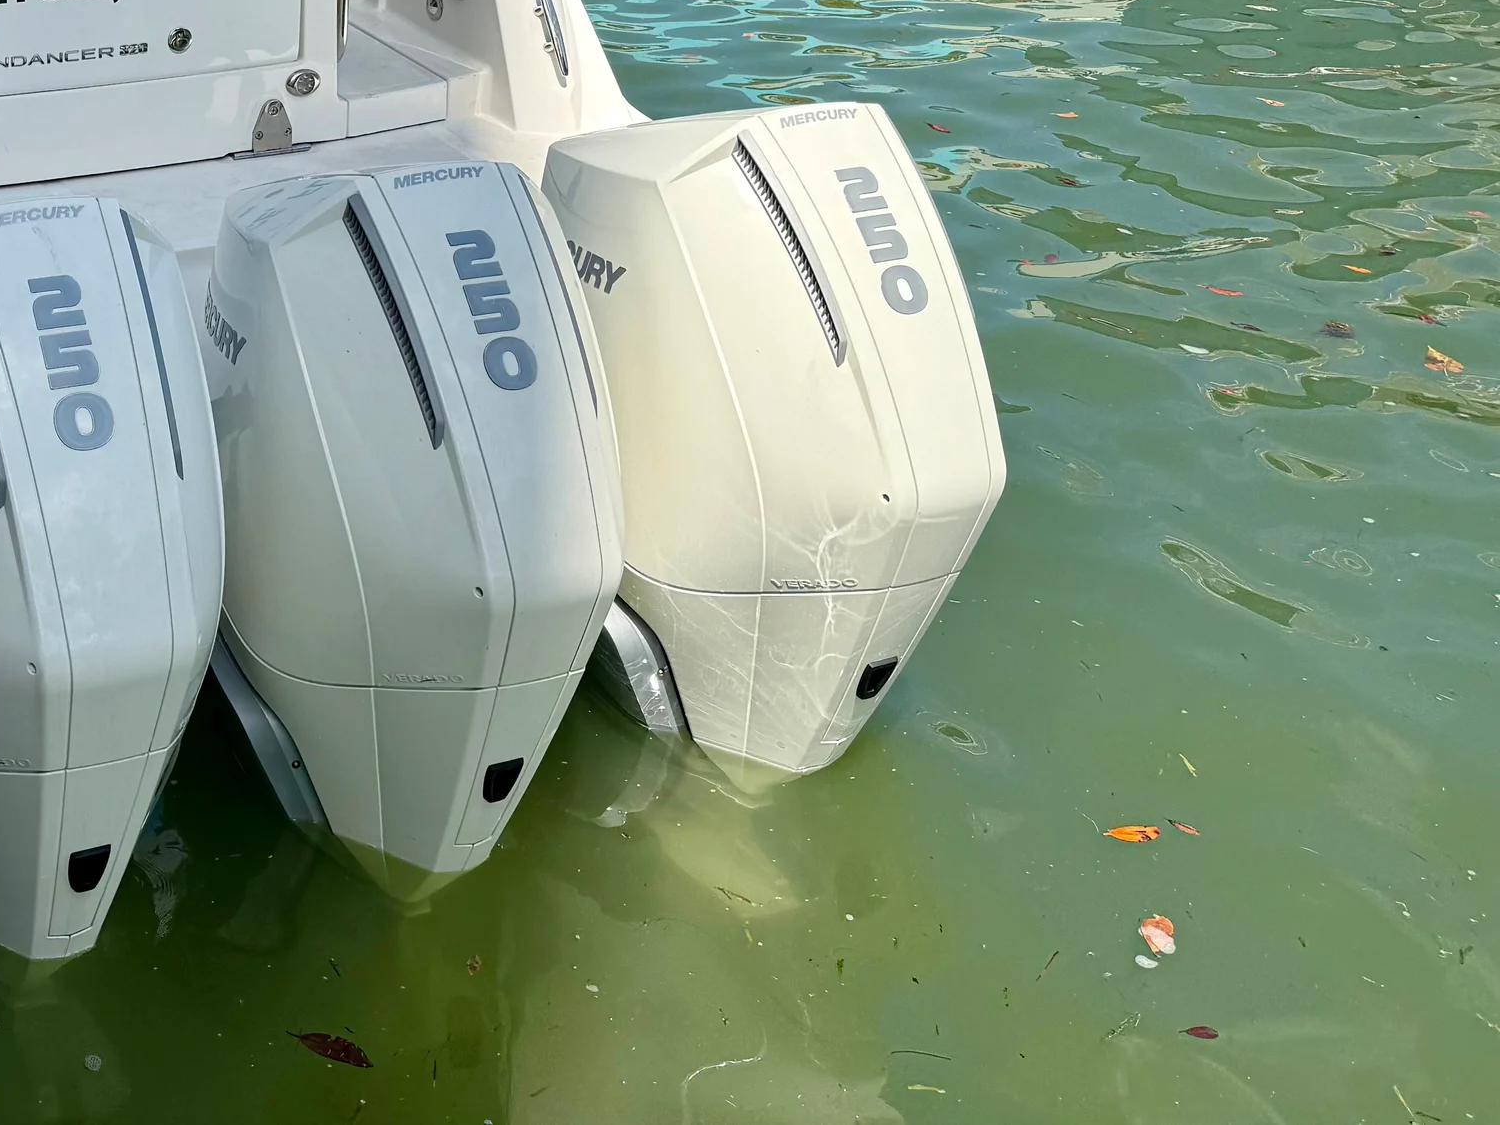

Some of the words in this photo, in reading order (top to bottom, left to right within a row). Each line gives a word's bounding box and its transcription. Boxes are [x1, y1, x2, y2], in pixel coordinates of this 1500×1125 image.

[119, 42, 149, 56] 320
[779, 107, 858, 129] MERCURY
[393, 165, 484, 189] MERCURY
[833, 166, 929, 316] 250
[445, 229, 538, 392] 250
[27, 274, 115, 452] 250
[769, 577, 859, 590] VERADO
[382, 672, 465, 684] VERADO
